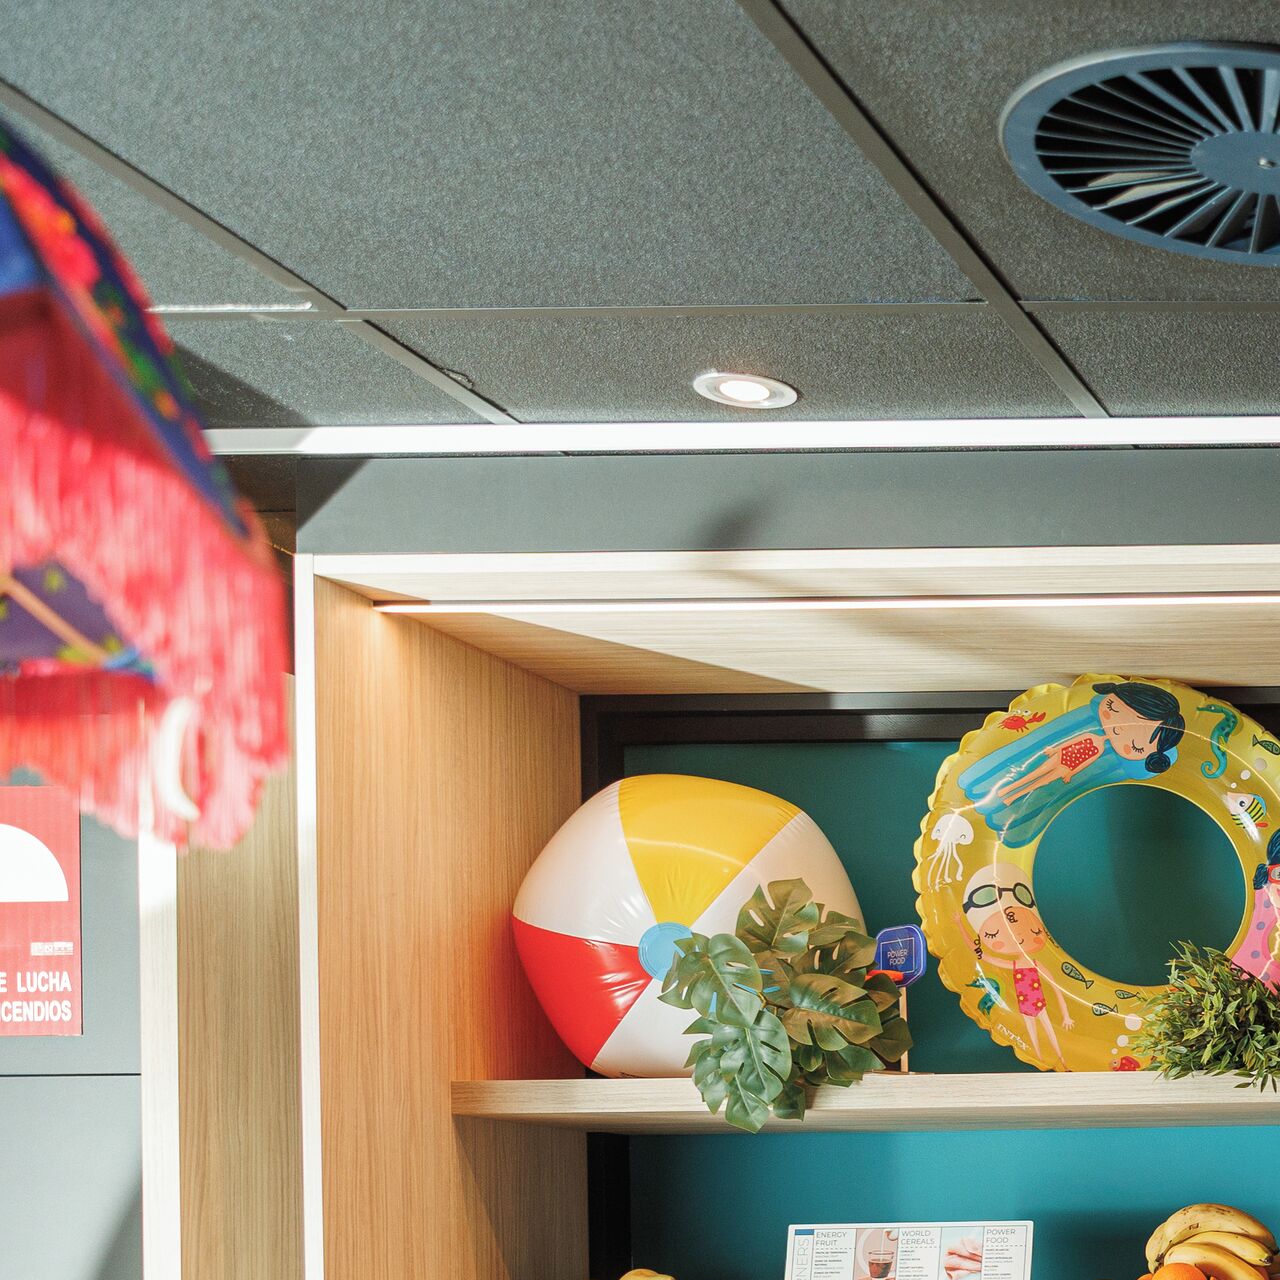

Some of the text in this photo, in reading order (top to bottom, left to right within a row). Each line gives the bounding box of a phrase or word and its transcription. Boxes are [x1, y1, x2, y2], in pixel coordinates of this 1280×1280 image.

[887, 949, 908, 959] POWER
[889, 957, 906, 966] FOOD
[17, 971, 72, 992] LUCHA
[0, 1000, 72, 1022] CENDIOS
[986, 1228, 1016, 1236] POWER
[986, 1236, 1009, 1244] FOOD
